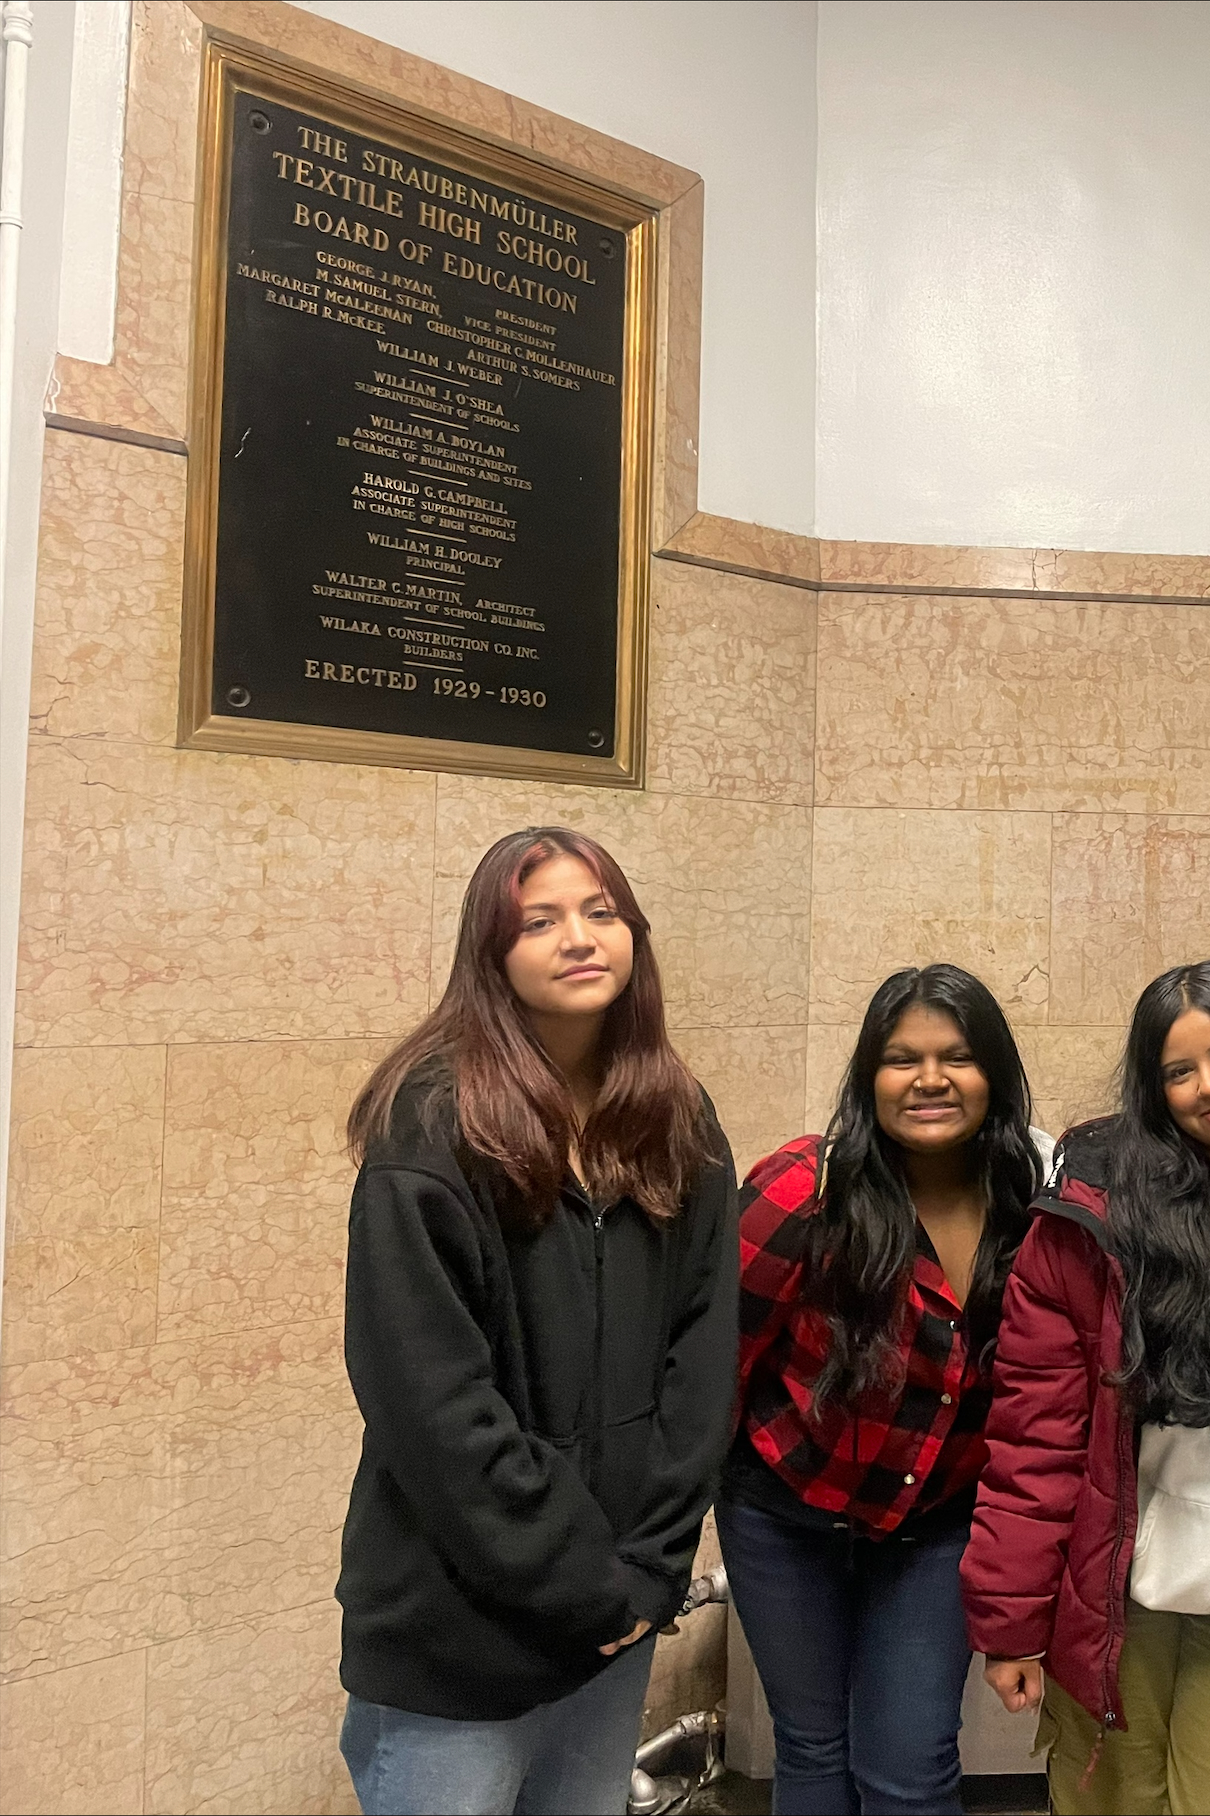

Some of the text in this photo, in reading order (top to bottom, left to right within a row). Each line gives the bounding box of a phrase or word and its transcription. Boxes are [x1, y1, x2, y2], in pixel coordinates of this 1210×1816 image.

[298, 126, 578, 245] THE STRAUBENMÜLLER
[273, 151, 596, 285] TEXTILE HIGH SCHOOL
[293, 202, 577, 314] BOARD OF EDUCATION
[316, 251, 375, 279] GEORGE
[495, 309, 557, 336] PRESIDENT
[333, 274, 392, 301] SAMUEL
[396, 293, 443, 319] STERN,
[464, 316, 491, 333] VICE
[495, 325, 557, 352] PRESIDENT
[236, 263, 321, 297] MARGARET
[427, 320, 511, 355] CHRISTOPHER
[525, 349, 616, 387] MOLLENHAUER
[265, 289, 318, 315] RALPH
[467, 349, 518, 373] ARTHUR
[532, 369, 581, 392] SOMERS
[373, 371, 436, 398] WILLIAM
[376, 340, 439, 368] WILLIAM
[457, 363, 503, 386] WEBER
[354, 381, 520, 433] SUPERINTENDENT OF SCHOOLS
[353, 427, 519, 475] ASSOCIATE SUPERINTENDENT
[370, 414, 433, 440] WILLIAM
[451, 435, 505, 458] BOYLAN
[336, 436, 532, 491] IN CHARGE OF BUILDINGS AND SITES
[351, 485, 517, 530] ASSOCIATE SUPERINTENDENT
[363, 472, 420, 495] HAROLD
[438, 489, 508, 515] CAMPBELL
[353, 500, 516, 542] IN CHARGE OF HIGH SCHOOLS
[366, 532, 430, 556] WILLIAM
[450, 548, 502, 570] DOOLEY
[405, 555, 465, 576] PRINCIPAL
[312, 584, 545, 632] SUPERINTENDENT OF SCHOOL BUILDINGS
[325, 570, 387, 591] WALTER
[475, 598, 536, 617] ARCHITECT
[320, 615, 382, 636] WILAKA
[387, 626, 490, 652] CONSTRUCTION
[516, 646, 540, 660] INC.
[403, 644, 464, 661] BUILDERS
[305, 659, 417, 691] ERECTED
